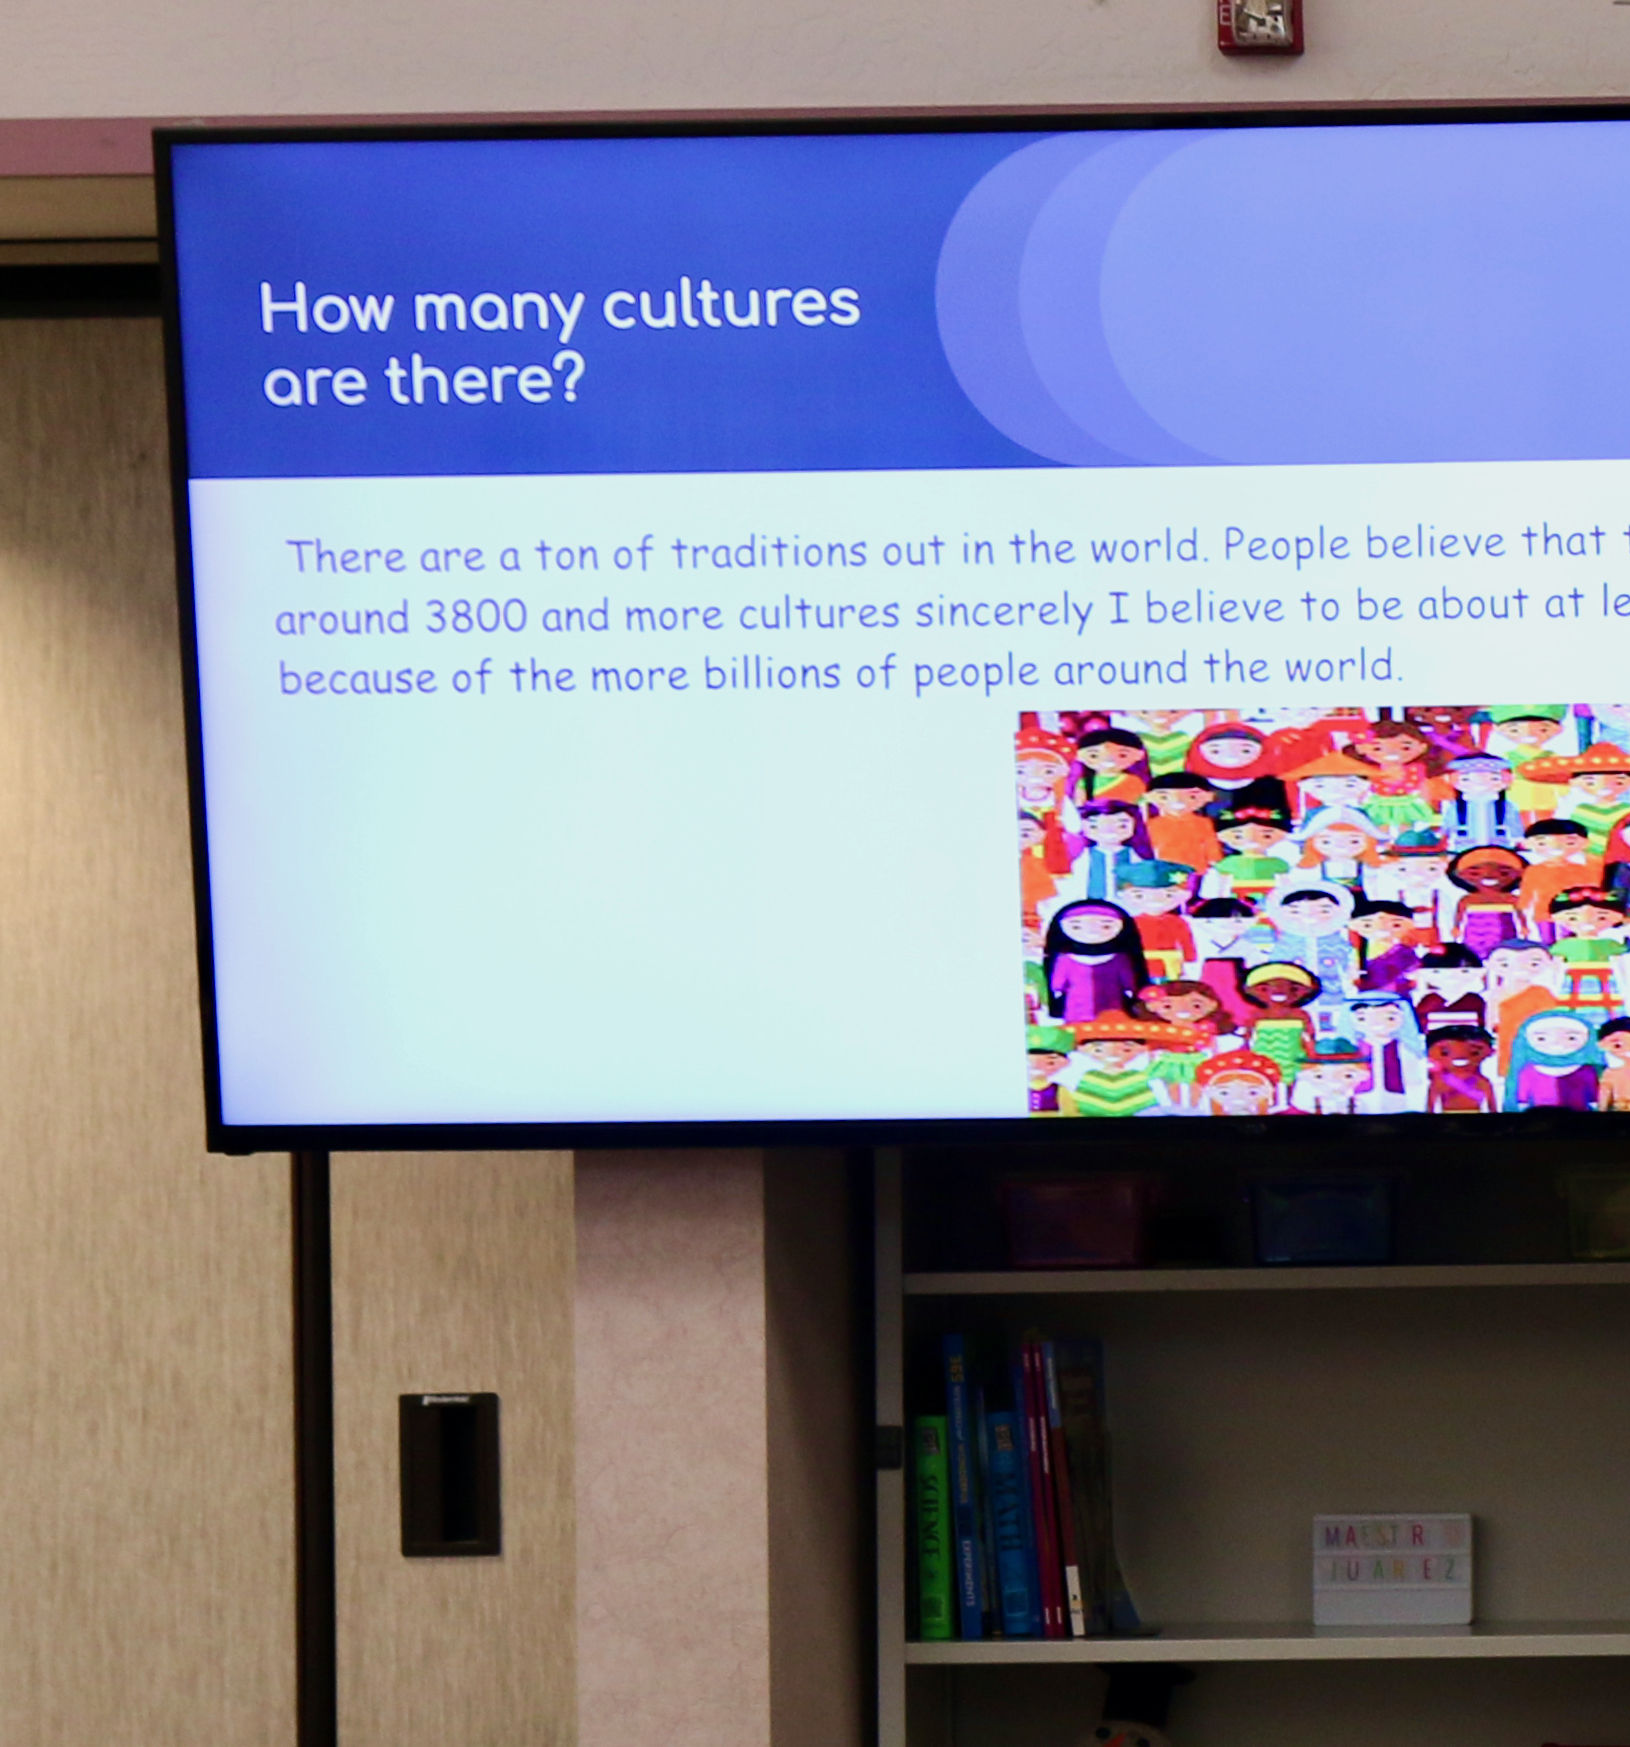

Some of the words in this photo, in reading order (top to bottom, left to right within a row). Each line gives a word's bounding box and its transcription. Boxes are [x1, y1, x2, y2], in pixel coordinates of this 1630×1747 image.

[260, 281, 393, 333] How
[414, 290, 584, 344] many
[601, 276, 861, 330] cultures
[263, 364, 368, 407] are
[384, 349, 585, 406] there?
[286, 538, 407, 574] There
[420, 544, 485, 573] are
[500, 543, 521, 572] a
[534, 538, 598, 572] ton
[613, 534, 653, 572] of
[671, 533, 868, 570] traditions
[882, 535, 945, 567] out
[962, 533, 994, 566] in
[1008, 529, 1076, 564] the
[1090, 527, 1211, 564] world.
[1224, 525, 1351, 571] People
[1366, 523, 1507, 559] believe
[1521, 522, 1607, 557] that
[275, 599, 409, 635] around
[425, 597, 527, 634] 3800
[541, 596, 610, 633] and
[624, 601, 723, 632] more
[738, 594, 899, 630] cultures
[915, 590, 1093, 635] sincerely
[1108, 592, 1130, 625] I
[1145, 589, 1284, 624] believe
[1300, 589, 1341, 622] to
[1356, 587, 1402, 622] be
[1417, 583, 1529, 620] about
[1544, 585, 1585, 618] at
[279, 661, 438, 695] because
[451, 657, 492, 694] of
[508, 658, 577, 692] the
[590, 663, 689, 690] more
[703, 653, 841, 690] billions
[855, 652, 897, 689] of
[914, 650, 1038, 697] people
[1054, 651, 1189, 687] around
[1204, 649, 1271, 684] the
[1284, 646, 1404, 683] world.
